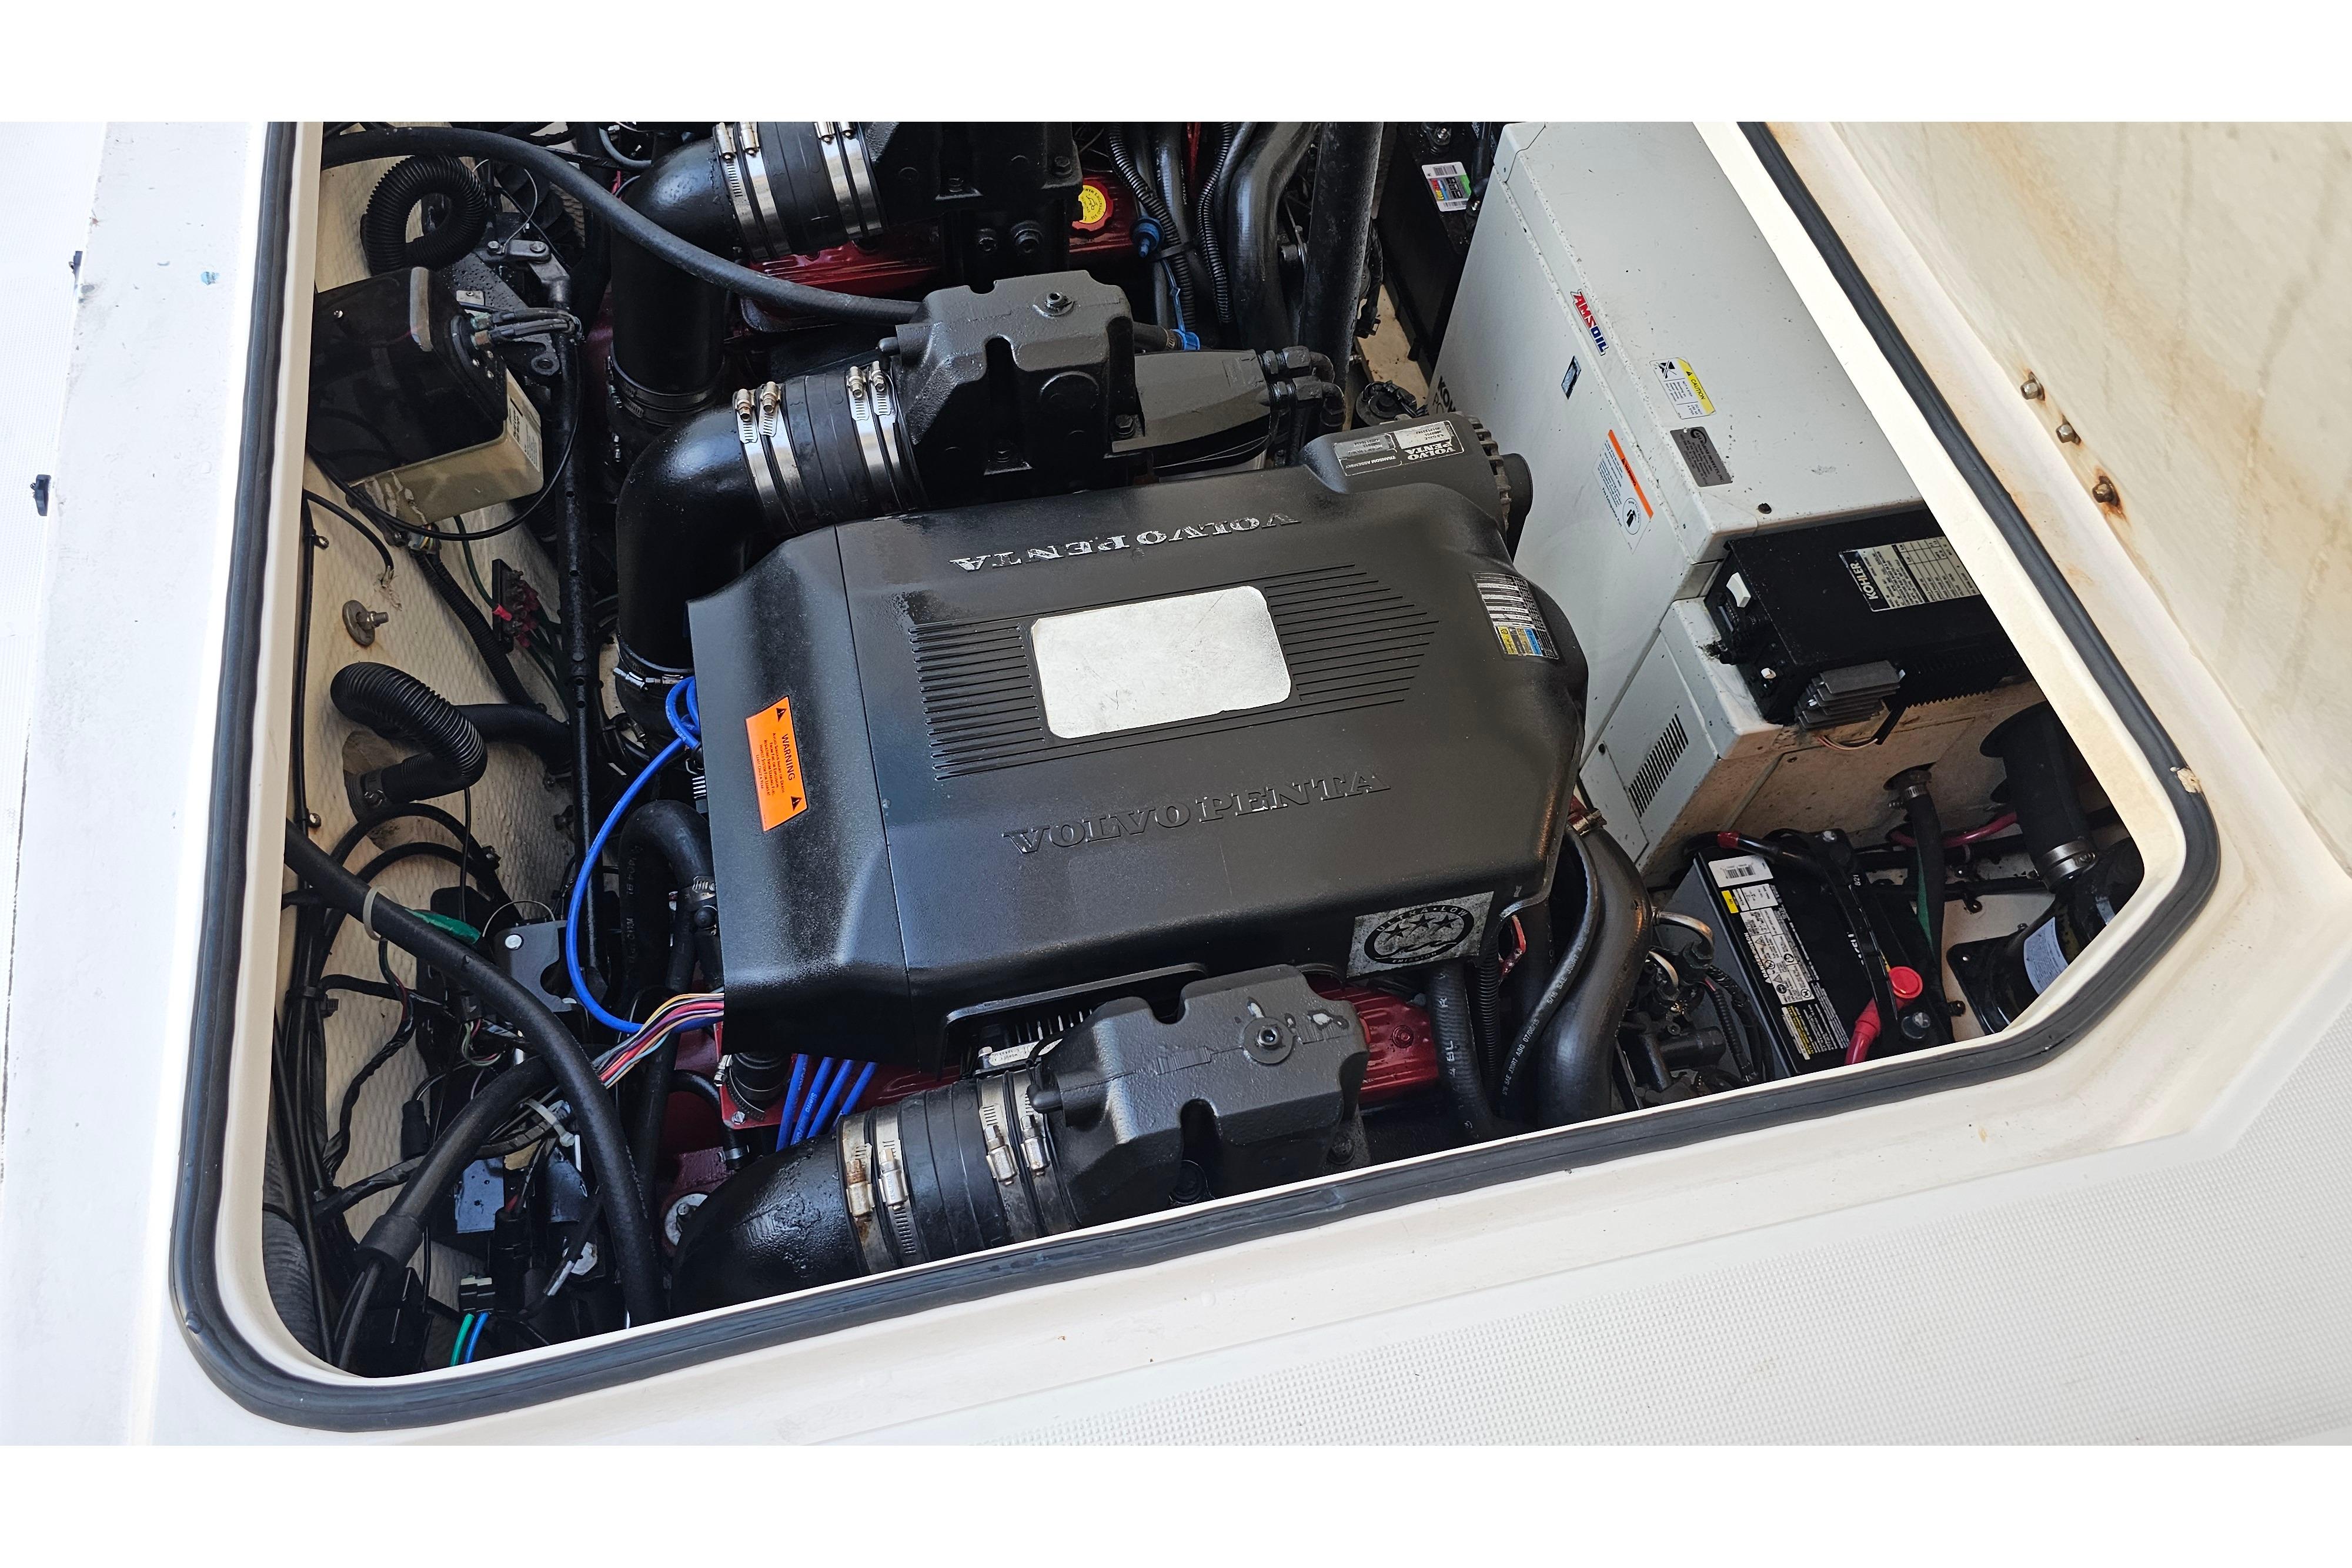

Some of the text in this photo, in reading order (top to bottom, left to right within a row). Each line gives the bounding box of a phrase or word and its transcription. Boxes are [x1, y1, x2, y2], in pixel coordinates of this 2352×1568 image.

[1572, 289, 1608, 355] AMSOIL
[1690, 378, 1706, 400] CAUTION
[1404, 442, 1453, 455] PENTA
[1407, 447, 1456, 460] VOLVO
[1345, 455, 1396, 469] TRANSOM ASSEMBLY
[1625, 463, 1636, 487] WARNING
[948, 512, 1302, 573] VOLVO PENTA
[1847, 562, 1880, 599] KOHLER
[781, 733, 796, 781] WARNING
[1002, 771, 1392, 854] VOLVO PENTA
[1441, 905, 1469, 917] LOW
[1556, 977, 1568, 989] SAE
[1515, 1044, 1525, 1057] ABG
[804, 1092, 818, 1113] Sierra
